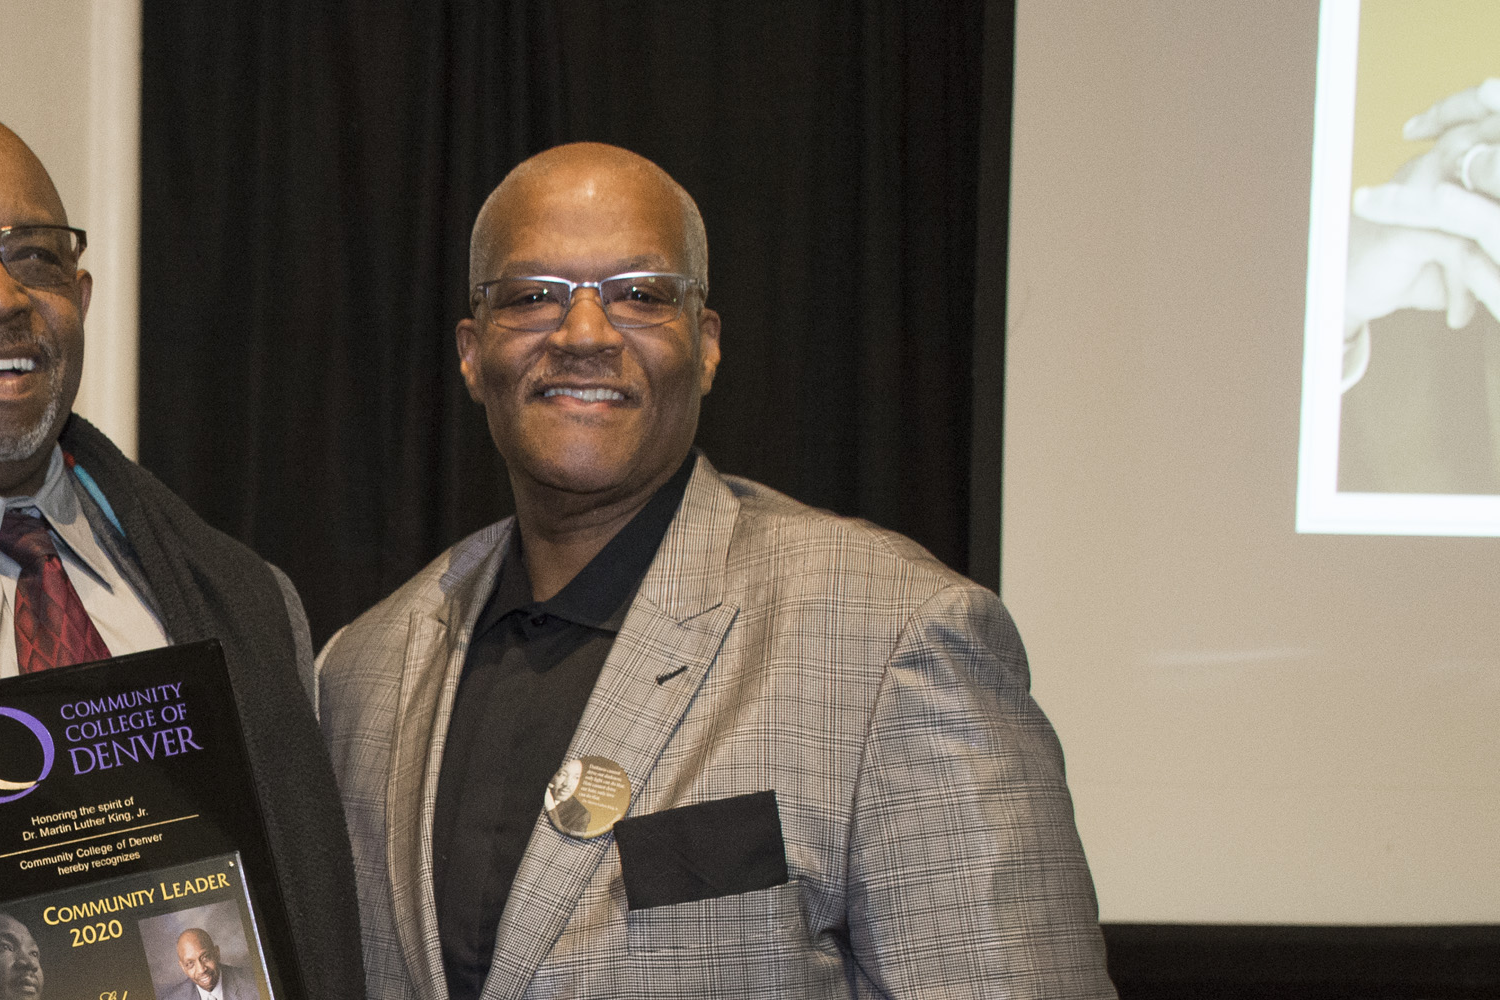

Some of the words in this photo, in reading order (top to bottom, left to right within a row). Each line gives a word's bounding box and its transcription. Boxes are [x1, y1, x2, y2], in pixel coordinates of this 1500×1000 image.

[60, 682, 182, 720] COMMUNITY
[65, 709, 157, 742] COLLEGE
[161, 703, 187, 723] OF
[68, 725, 204, 775] DENVER
[22, 830, 38, 841] Dr.
[39, 823, 72, 838] Martin
[74, 815, 106, 831] Luther
[107, 811, 135, 824] King,
[136, 807, 149, 818] Jr.
[31, 809, 78, 826] Honoring
[79, 806, 96, 817] the
[97, 799, 122, 813] spirit
[124, 796, 134, 807] of
[19, 852, 74, 870] Community
[76, 843, 113, 858] College
[116, 840, 126, 850] of
[128, 833, 163, 848] Denver
[57, 862, 89, 876] hereby
[91, 851, 141, 868] recognizes
[69, 919, 123, 948] 2020
